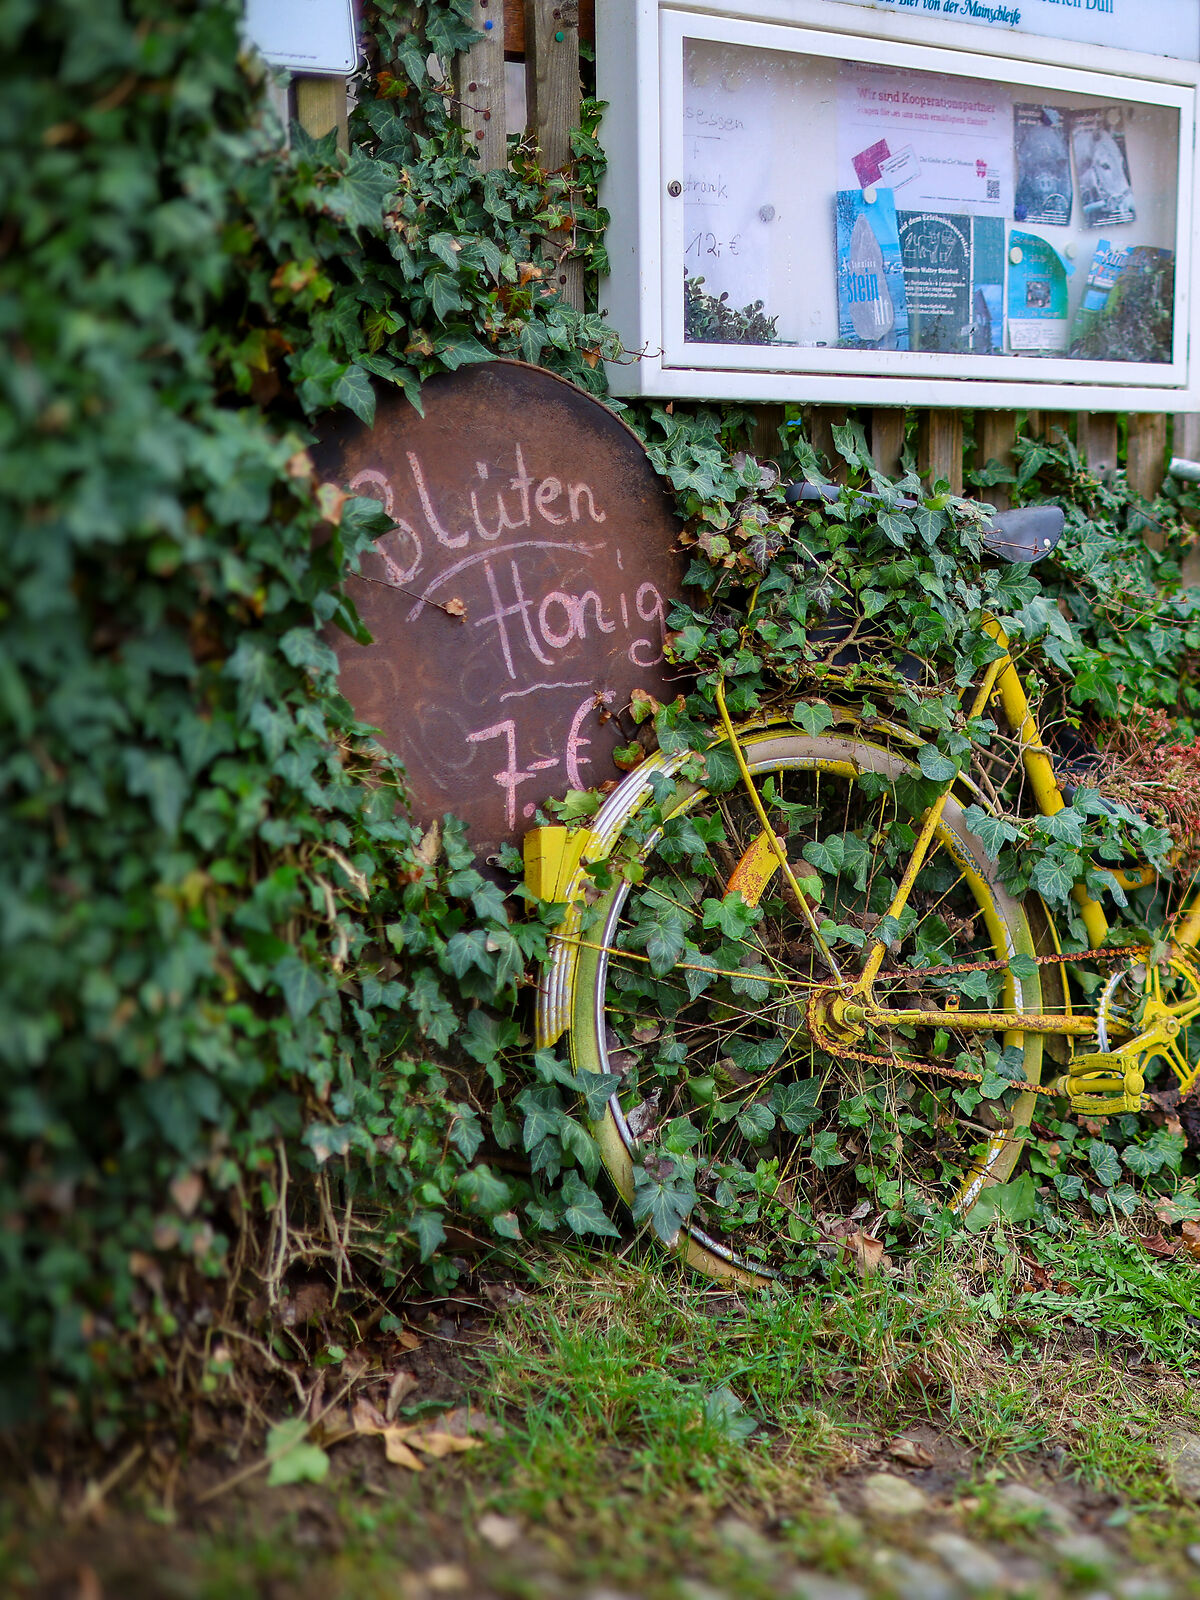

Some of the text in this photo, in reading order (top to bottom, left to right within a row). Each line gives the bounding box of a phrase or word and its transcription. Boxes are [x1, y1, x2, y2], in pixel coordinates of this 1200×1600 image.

[943, 0, 960, 13] der
[960, 1, 1022, 26] Mainschleife
[878, 91, 900, 103] sind
[902, 92, 996, 113] Kooperationspartner
[349, 442, 606, 586] Blüten
[474, 548, 666, 679] Honig
